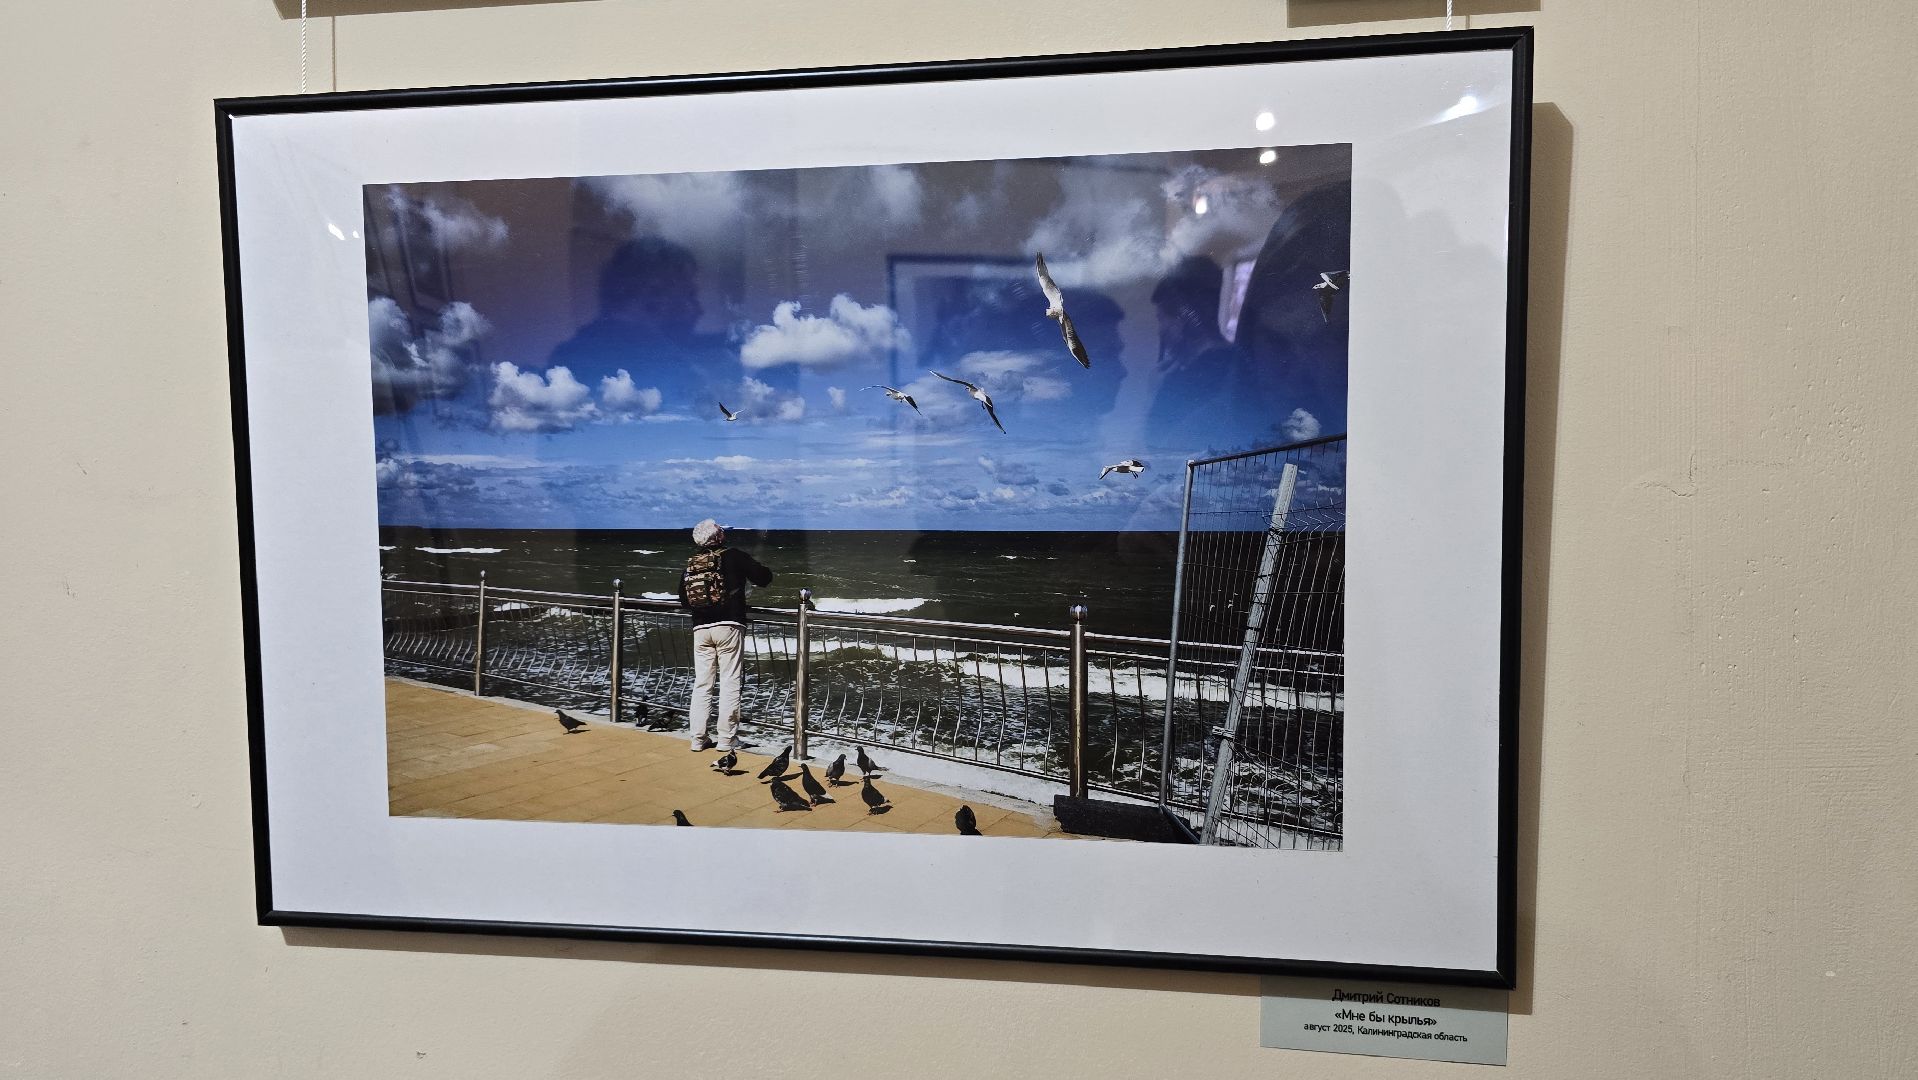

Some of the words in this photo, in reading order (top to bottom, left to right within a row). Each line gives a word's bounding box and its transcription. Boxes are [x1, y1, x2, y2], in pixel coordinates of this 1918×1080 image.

[1332, 989, 1385, 1003] Дмитрий
[1387, 993, 1440, 1007] Сотников
[1335, 1009, 1365, 1022] «Мне
[1368, 1011, 1385, 1023] бы
[1388, 1014, 1437, 1027] крылья»
[1303, 1023, 1330, 1035] август
[1333, 1024, 1355, 1035] 2025,
[1357, 1026, 1432, 1040] Калининградская
[1434, 1031, 1468, 1042] область
